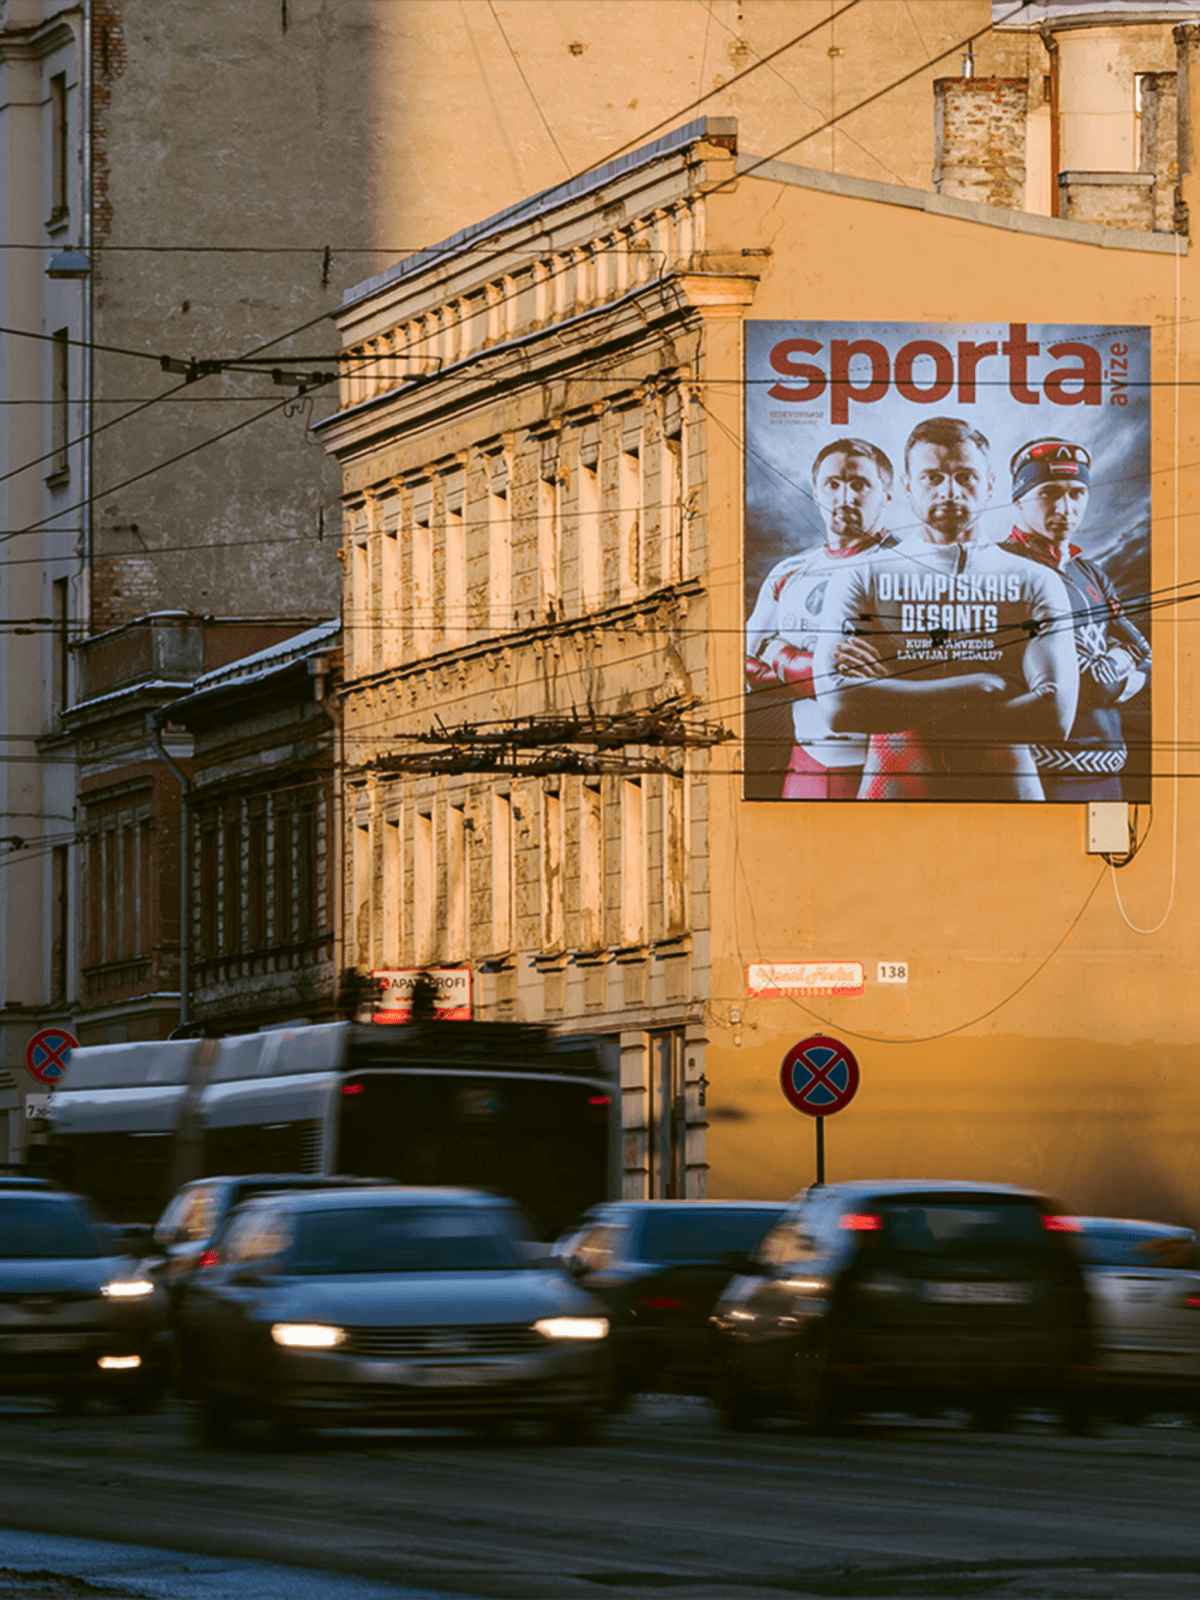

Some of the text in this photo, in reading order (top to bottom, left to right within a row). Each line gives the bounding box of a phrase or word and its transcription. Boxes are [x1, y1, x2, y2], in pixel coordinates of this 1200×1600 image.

[767, 323, 1101, 424] sporta
[1104, 342, 1128, 407] avīze
[879, 573, 1020, 602] OLIMPISKAIS
[902, 603, 998, 633] DESANTS
[897, 650, 948, 660] LATVIJAI
[880, 966, 906, 978] 138
